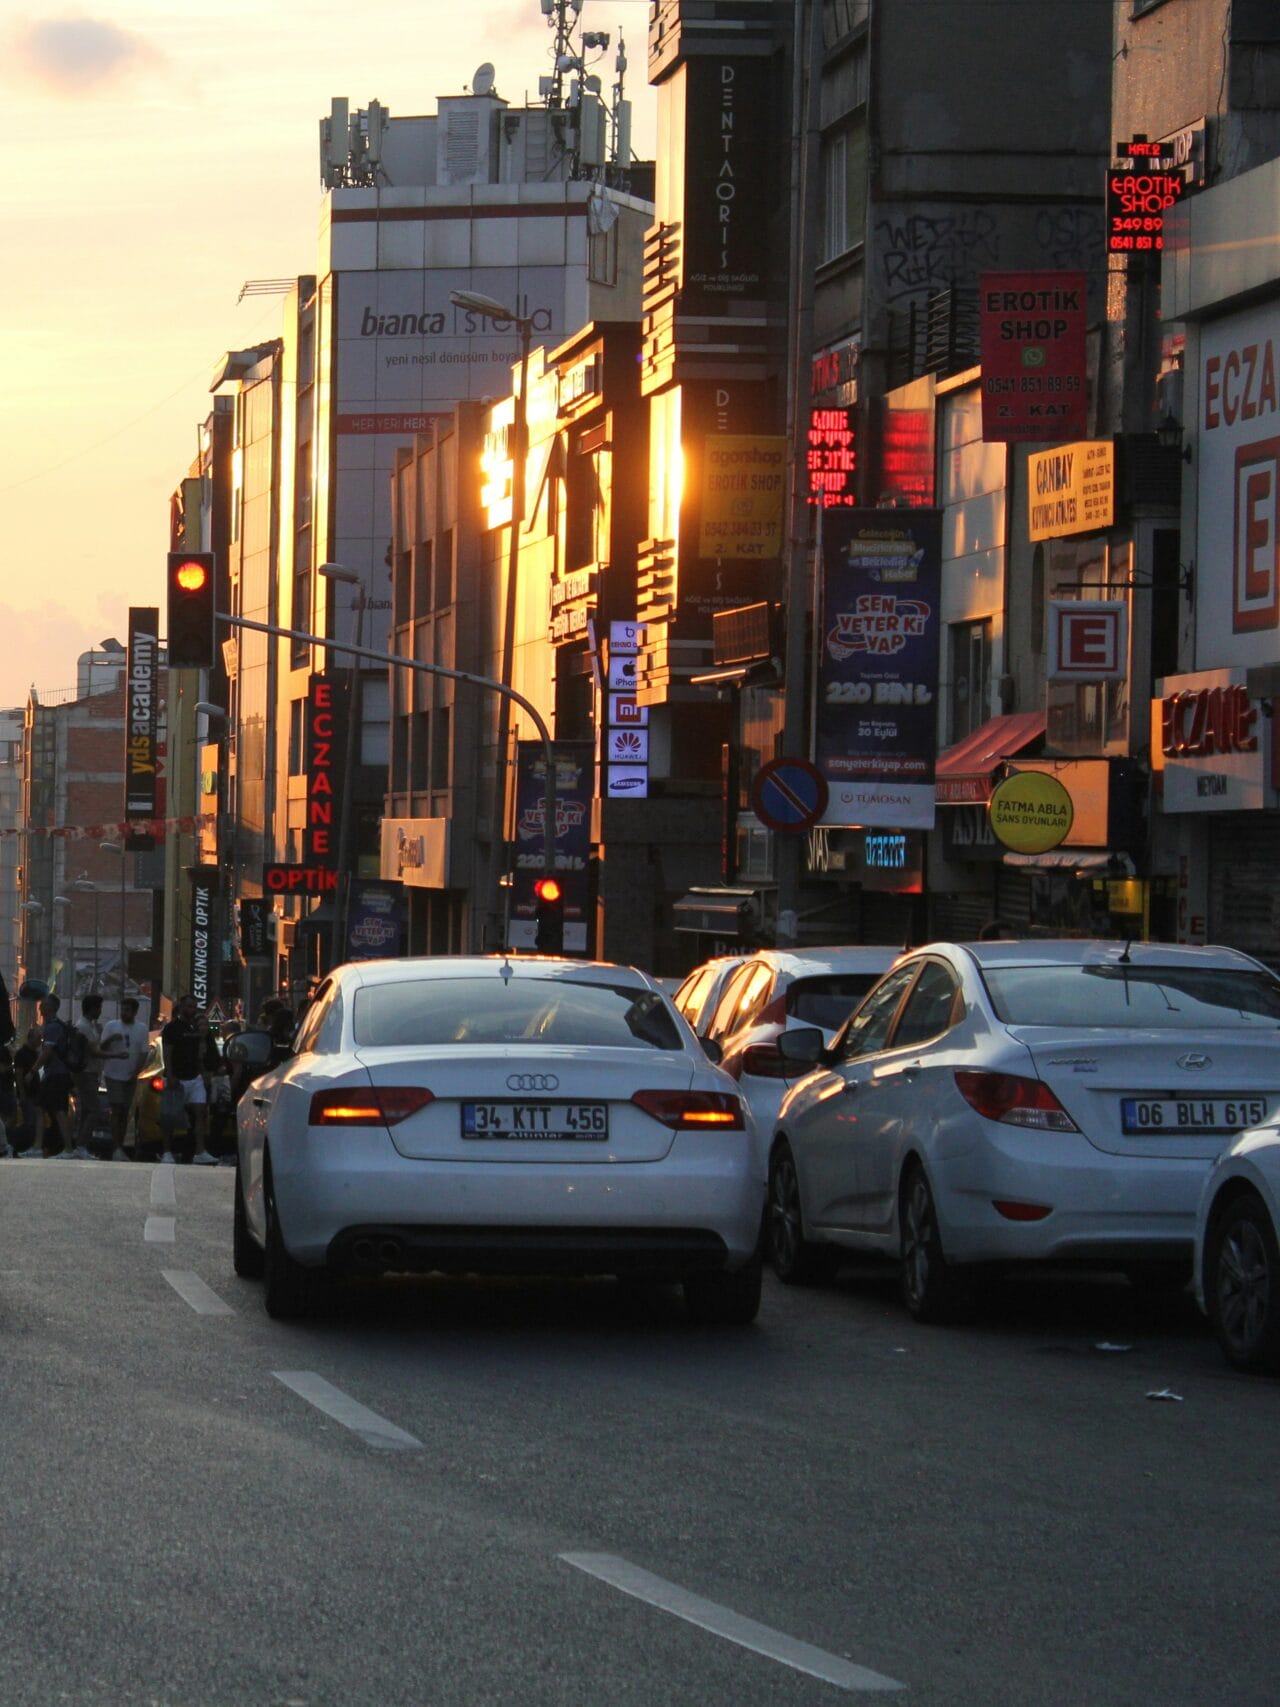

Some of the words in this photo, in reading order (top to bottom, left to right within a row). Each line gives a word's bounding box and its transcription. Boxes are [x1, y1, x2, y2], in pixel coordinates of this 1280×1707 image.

[1111, 173, 1181, 194] EROTİK
[1120, 195, 1176, 213] SHOP
[986, 286, 1080, 313] EROTİK
[360, 306, 445, 336] bianca
[1000, 319, 1068, 341] SHOP
[385, 353, 408, 368] yeni
[412, 351, 437, 365] nesil
[1205, 338, 1280, 431] ECZA
[1029, 404, 1070, 417] KAT
[403, 415, 427, 429] HER
[750, 474, 781, 491] SHOP
[858, 596, 896, 613] SEN
[868, 634, 905, 653] YAP
[1070, 619, 1107, 664] E
[615, 677, 638, 687] iPhon
[126, 632, 158, 774] ydsacademy
[825, 682, 872, 706] 220
[1161, 683, 1258, 759] ECZANE
[310, 684, 333, 853] ECZANE
[828, 758, 927, 773] senyeterkiyap.com
[997, 800, 1035, 814] FATMA
[1036, 803, 1068, 816] ABLA
[476, 1106, 501, 1130] 34
[512, 1106, 552, 1130] KTT
[565, 1107, 605, 1131] 456
[1137, 1103, 1163, 1126] 06
[1176, 1103, 1216, 1126] BLH
[1225, 1103, 1262, 1125] 615
